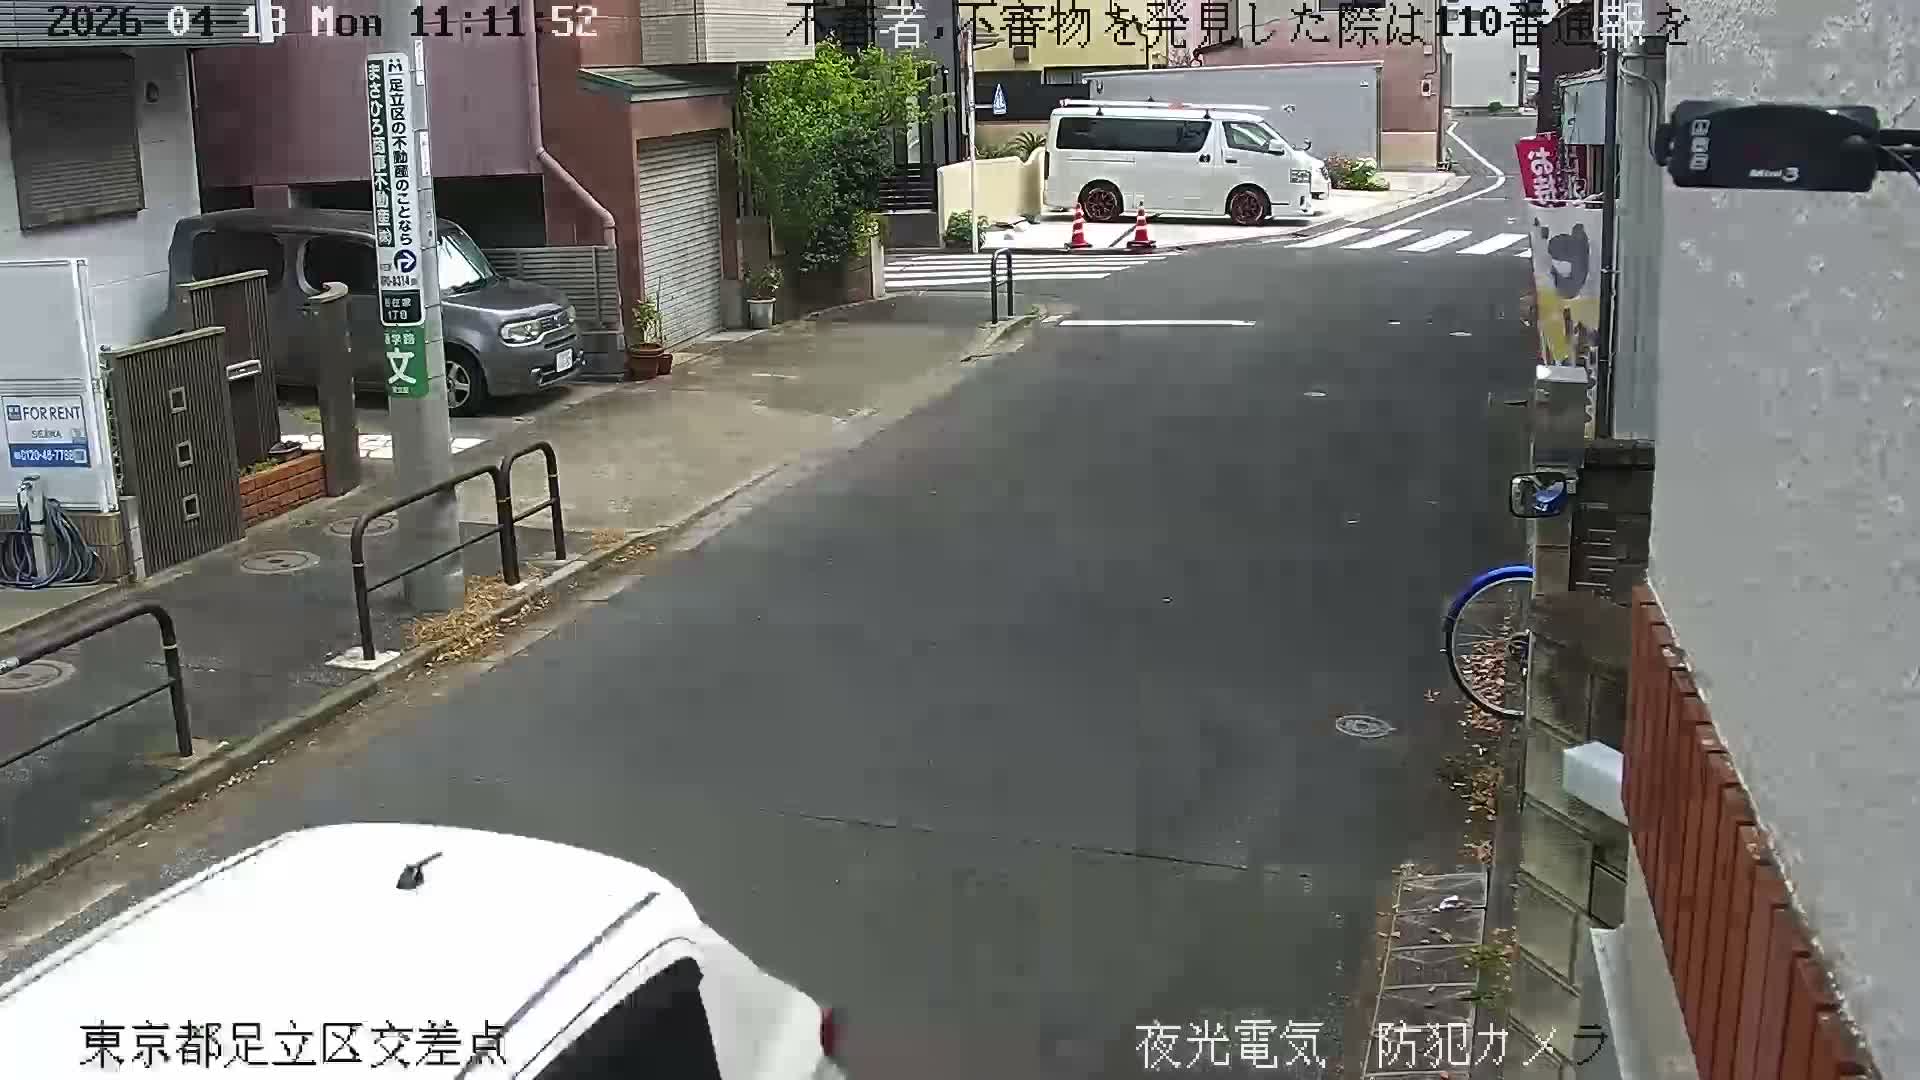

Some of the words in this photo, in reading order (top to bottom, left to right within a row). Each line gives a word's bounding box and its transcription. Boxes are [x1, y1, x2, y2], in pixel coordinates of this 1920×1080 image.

[389, 78, 413, 246] 足立区の不動産のことなら
[386, 346, 417, 384] 文
[22, 406, 48, 420] FOR
[49, 405, 80, 420] RENT
